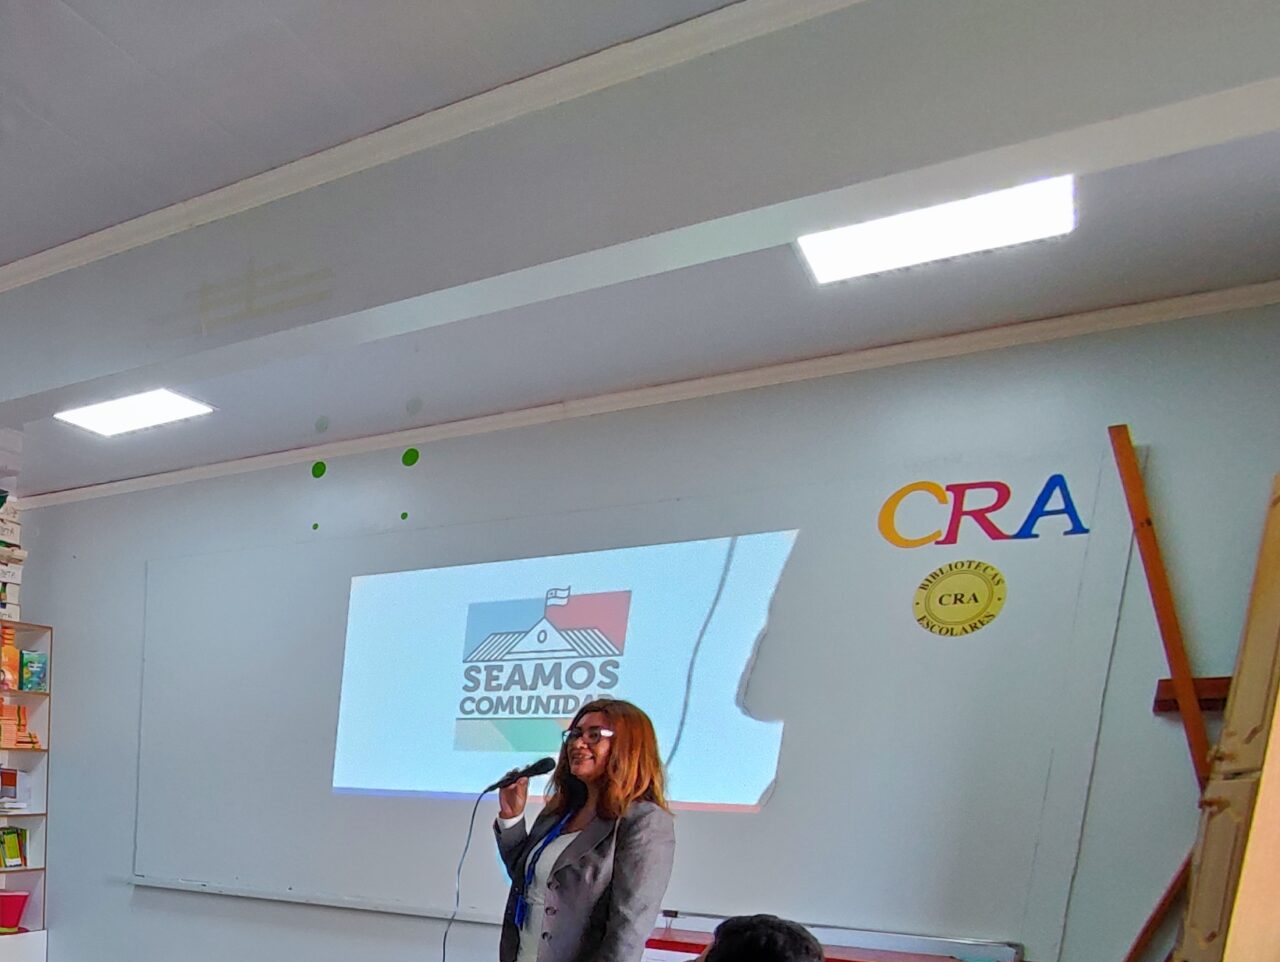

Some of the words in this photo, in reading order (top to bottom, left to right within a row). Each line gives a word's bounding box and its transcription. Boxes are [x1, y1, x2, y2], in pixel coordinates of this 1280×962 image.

[878, 474, 1090, 548] CRA
[919, 560, 1005, 591] BIBLIOTECAS
[938, 592, 979, 606] CRA
[916, 612, 996, 637] ESCOLARES
[462, 660, 620, 692] SEAMOS
[459, 694, 615, 715] COMUNID
